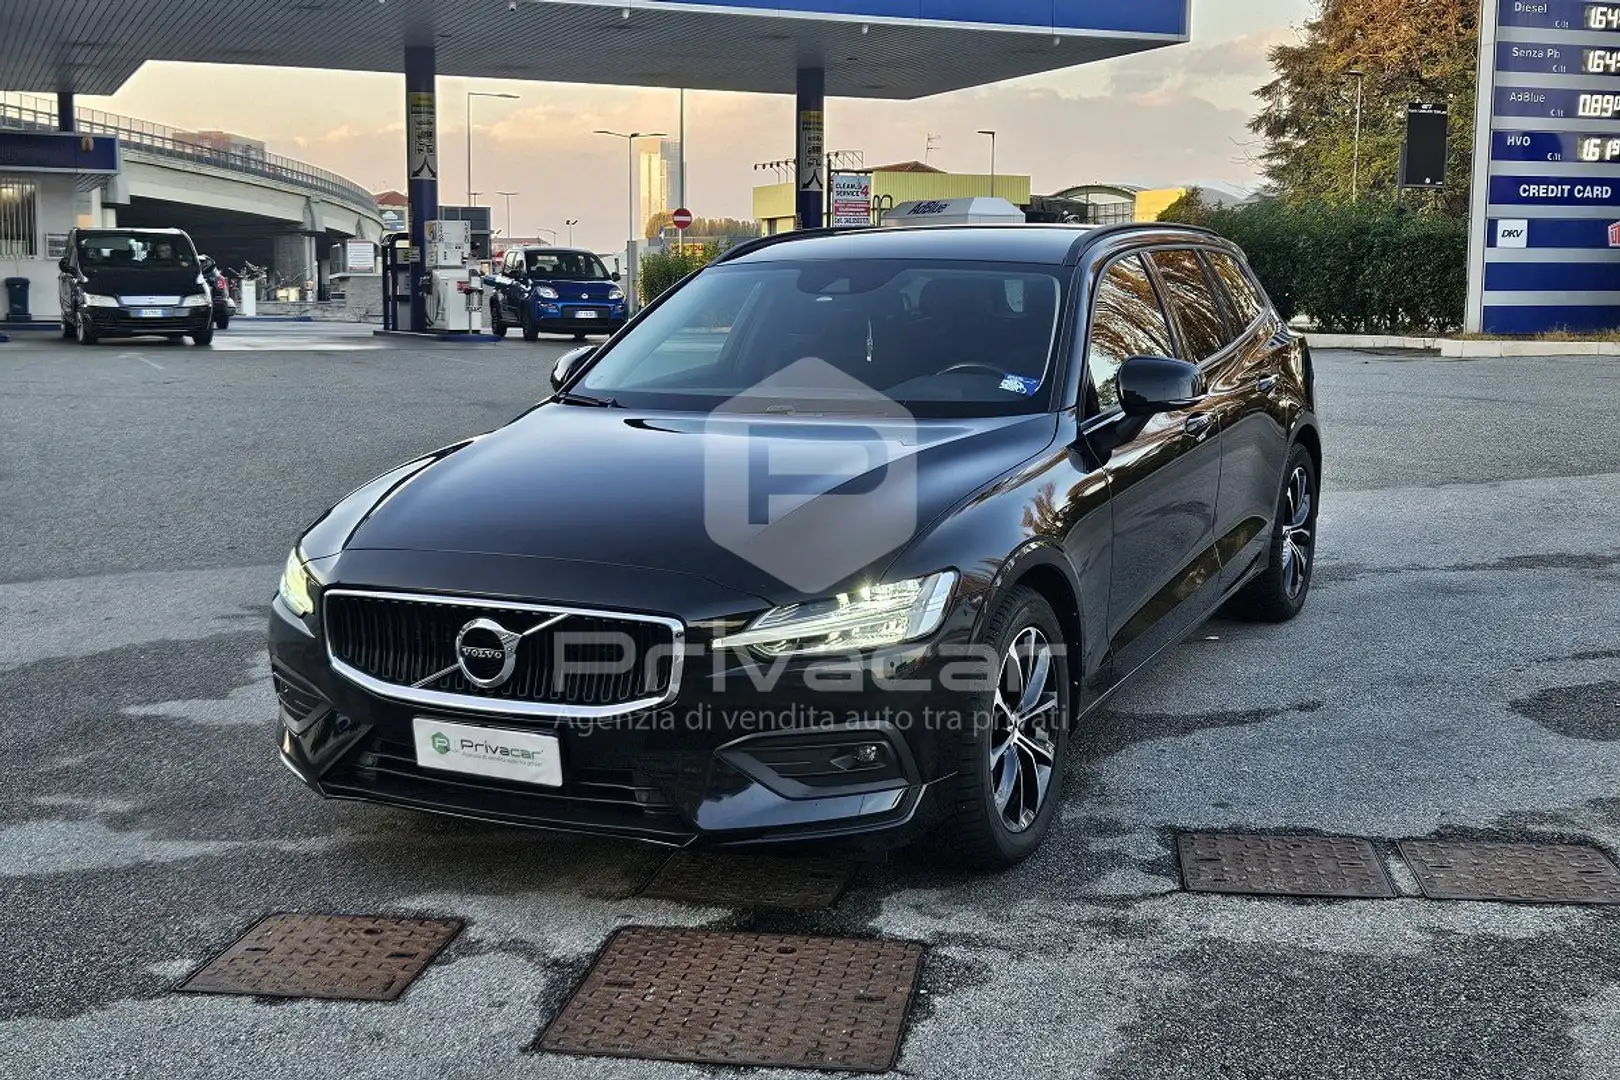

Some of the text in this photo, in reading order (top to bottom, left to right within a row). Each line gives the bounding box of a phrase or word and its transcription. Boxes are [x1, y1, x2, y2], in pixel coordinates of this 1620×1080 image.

[1514, 2, 1547, 13] Diesel
[1512, 47, 1561, 58] Senza Pb
[1509, 91, 1545, 103] AdBlue
[1506, 136, 1531, 147] HVO
[1519, 184, 1612, 199] CREDIT CARD
[1501, 229, 1523, 238] DKV
[462, 648, 502, 659] VOLVO
[460, 739, 543, 760] Privacar
